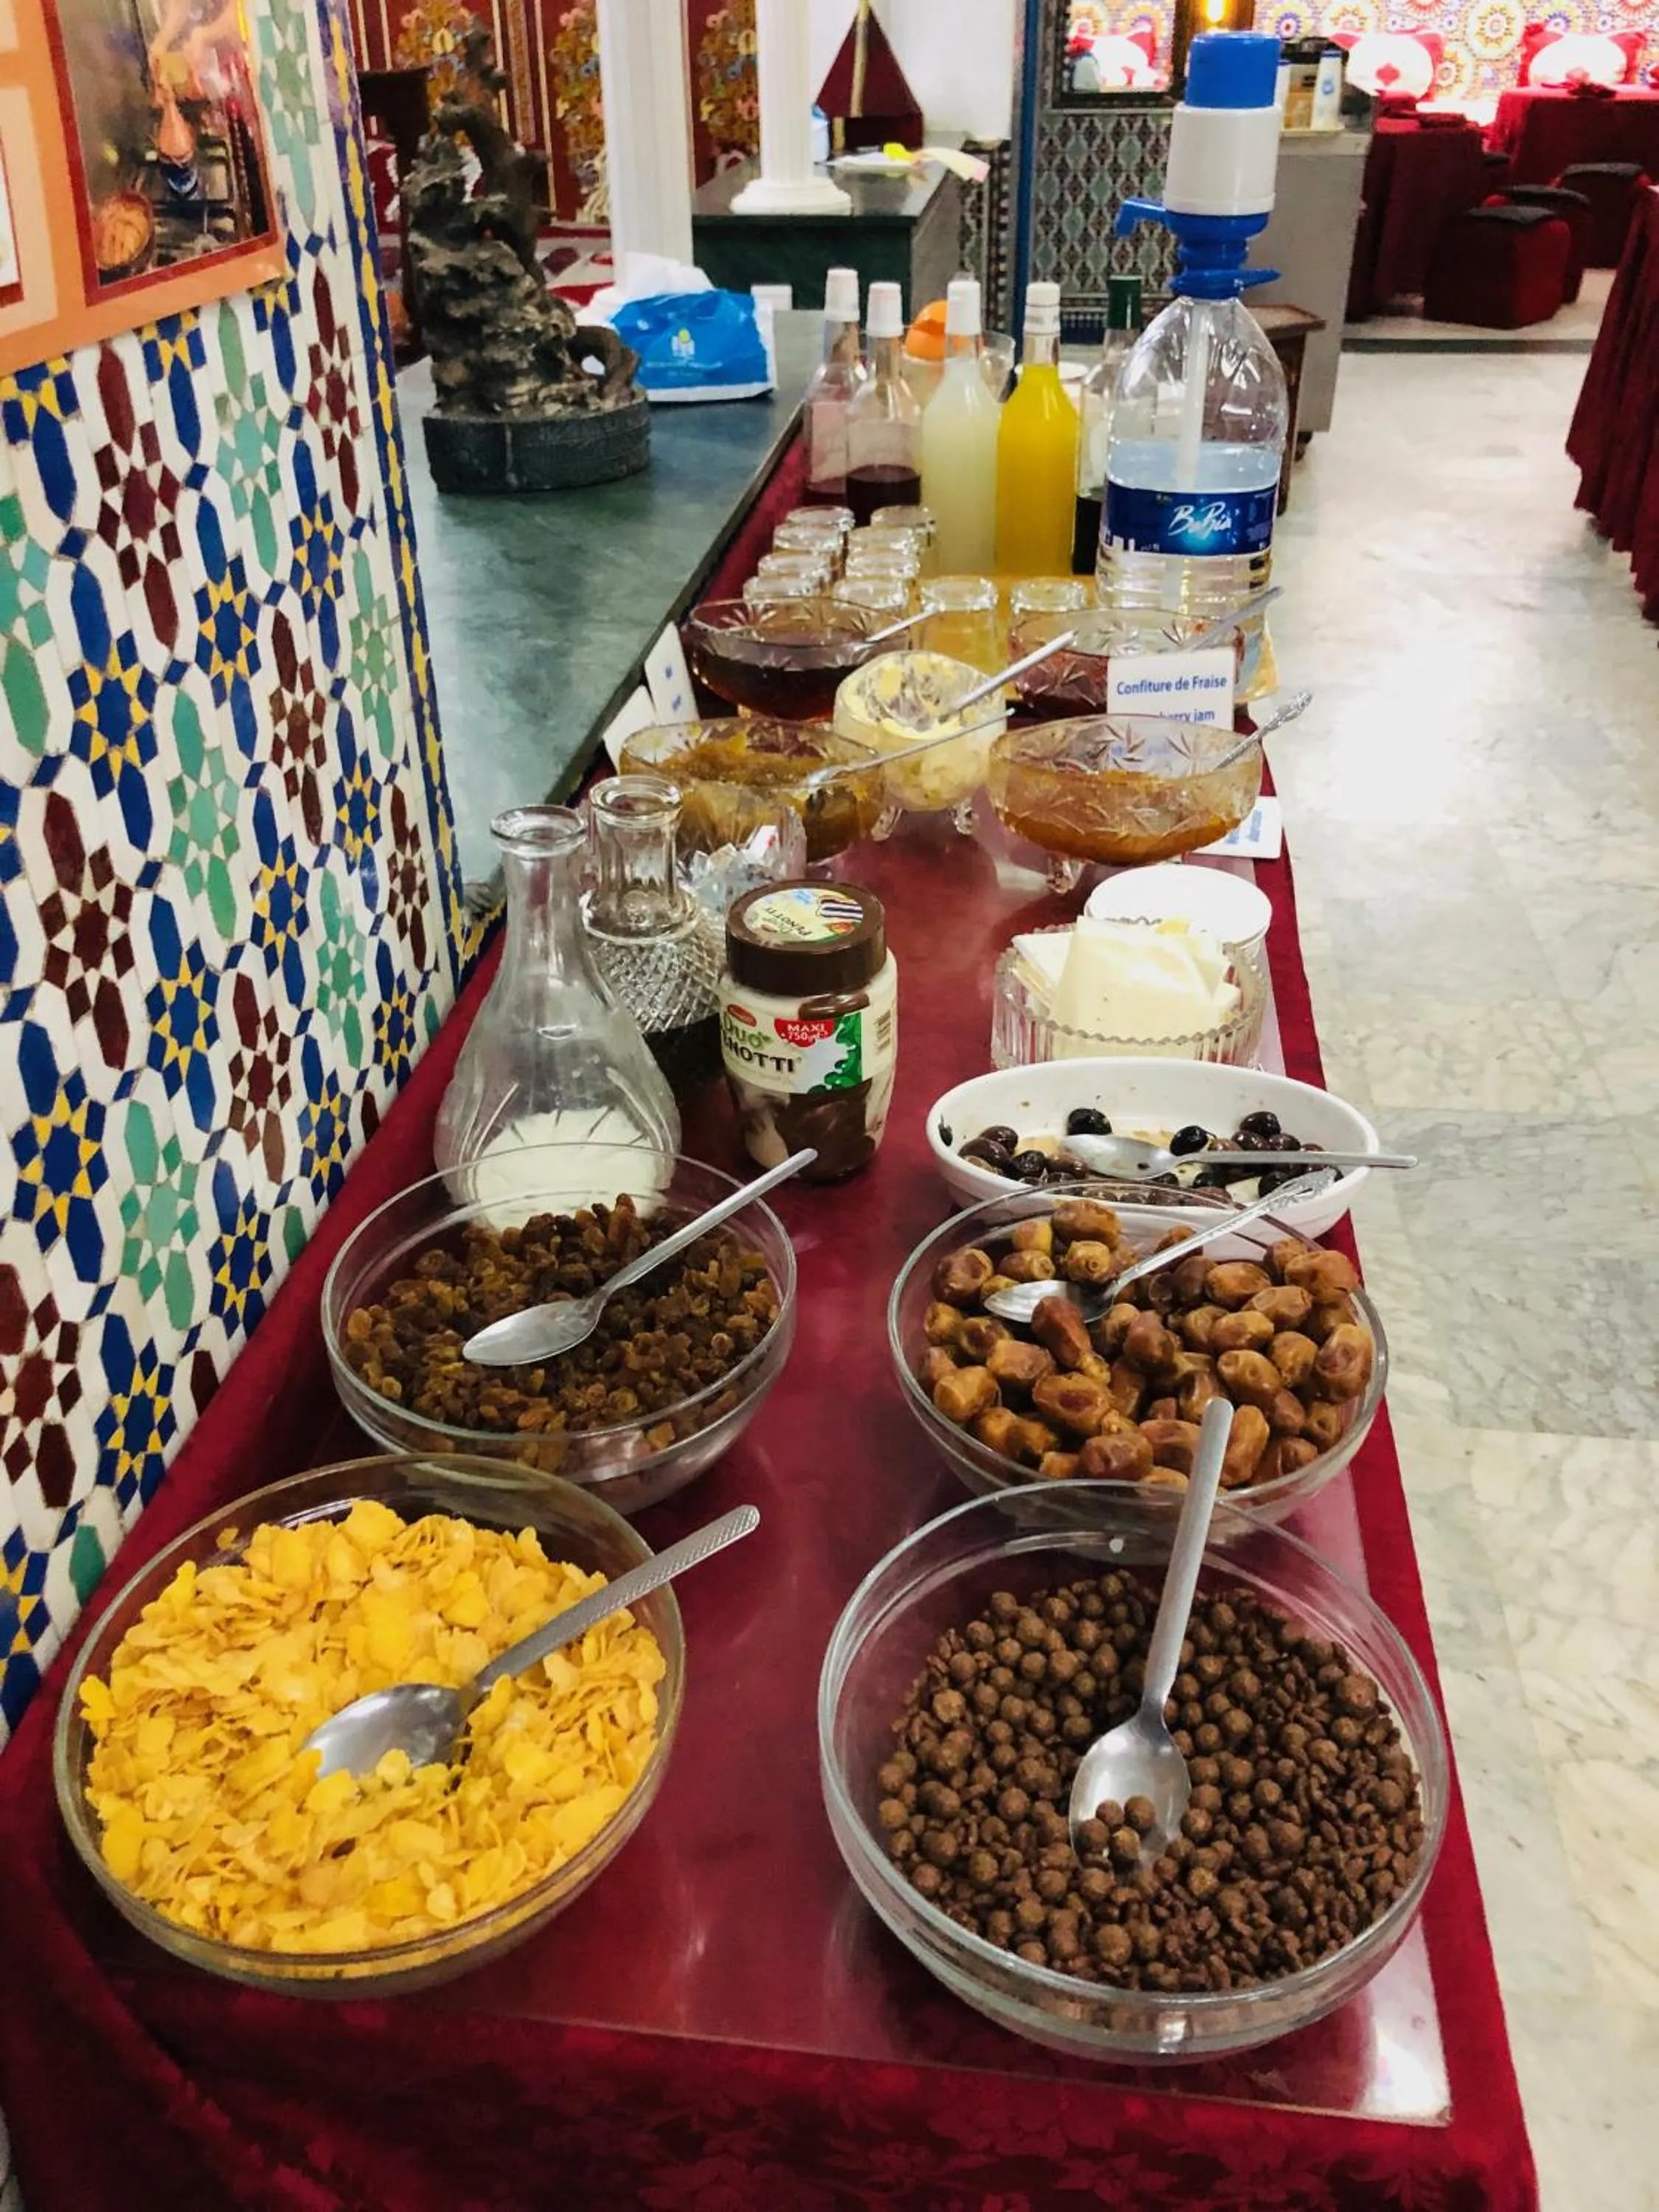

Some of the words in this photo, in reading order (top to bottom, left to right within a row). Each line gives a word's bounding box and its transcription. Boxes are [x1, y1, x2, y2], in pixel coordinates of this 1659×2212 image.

[1116, 680, 1172, 695] Confiture
[1175, 676, 1189, 691] de
[1192, 675, 1228, 689] Fraise
[1193, 708, 1215, 724] jam
[787, 1023, 825, 1032] MAXI
